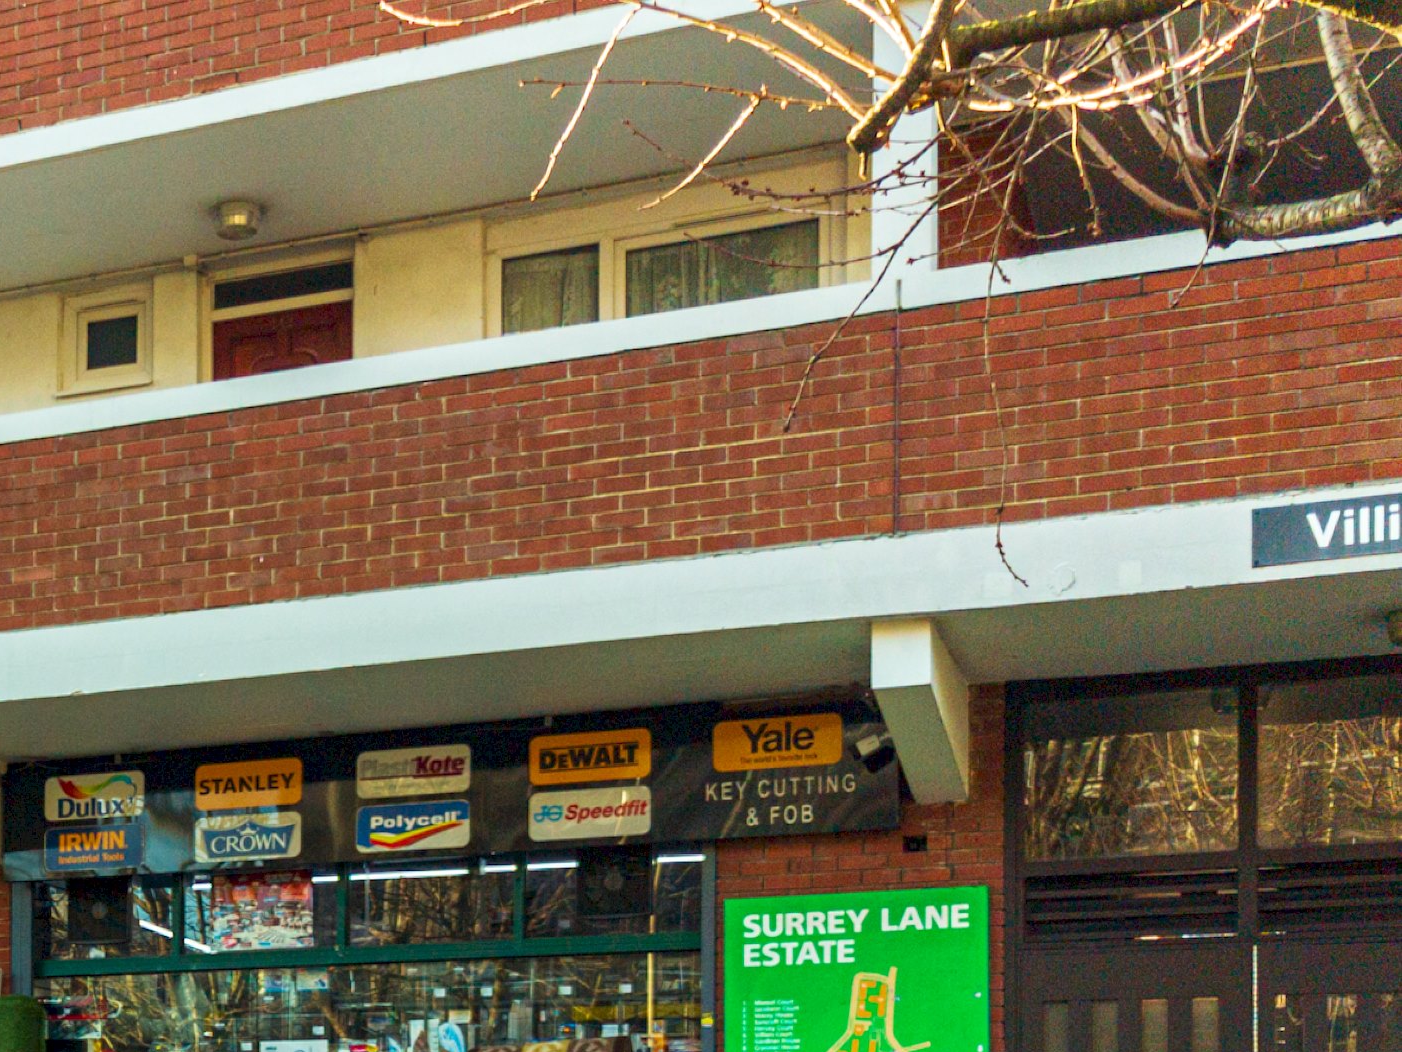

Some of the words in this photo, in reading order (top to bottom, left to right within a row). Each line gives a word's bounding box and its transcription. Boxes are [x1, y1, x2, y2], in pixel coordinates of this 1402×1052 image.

[1305, 503, 1400, 548] Villi
[742, 722, 815, 753] Yale
[199, 773, 295, 796] STANLEY
[705, 781, 747, 801] KEY
[757, 773, 857, 799] CUTTING
[58, 797, 125, 818] Dulux
[565, 800, 648, 824] Speedfit
[746, 807, 759, 826] &
[770, 804, 814, 824] FOB
[370, 810, 459, 831] Polycell
[59, 830, 126, 853] IRWIN
[210, 833, 287, 854] CROWN
[58, 855, 100, 865] Industrial
[102, 853, 125, 862] Tools
[743, 908, 870, 938] SURREY
[880, 903, 970, 932] LANE
[743, 939, 856, 967] ESTATE
